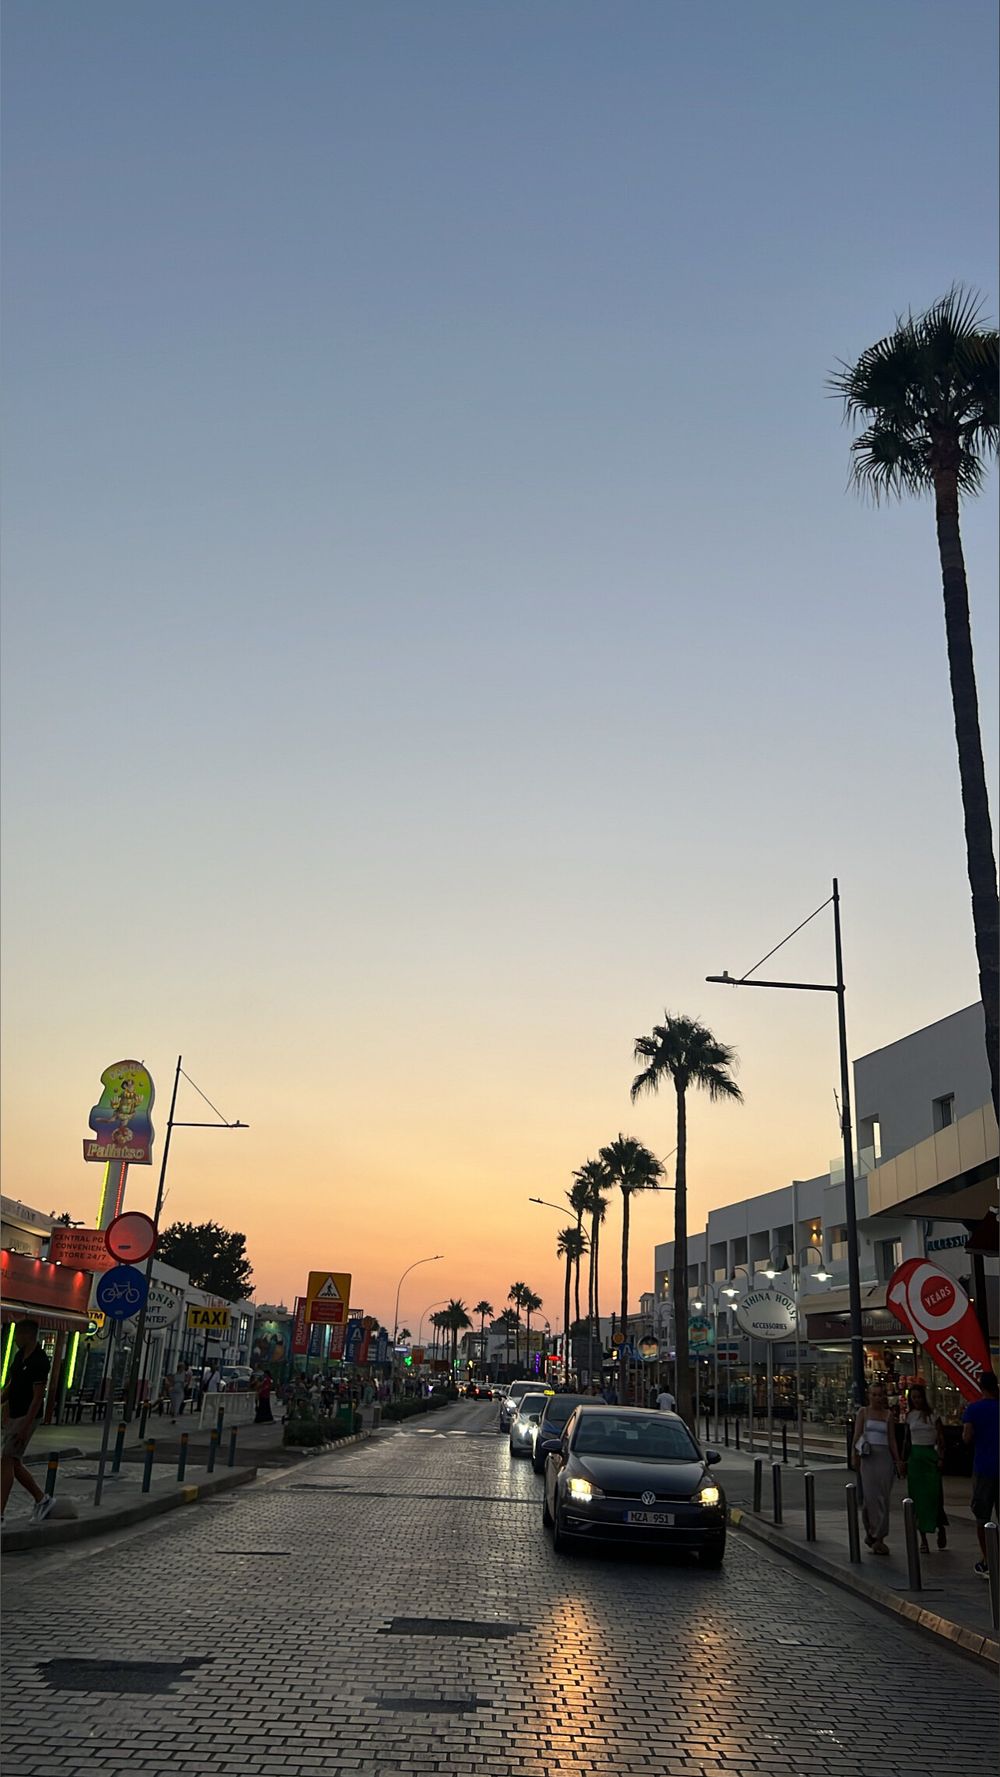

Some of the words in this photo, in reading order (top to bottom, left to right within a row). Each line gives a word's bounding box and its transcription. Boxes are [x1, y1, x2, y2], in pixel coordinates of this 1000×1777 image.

[55, 1234, 89, 1242] CENTRAL
[56, 1243, 107, 1252] CONVENIENC
[149, 1292, 175, 1308] ONIS
[925, 1286, 951, 1307] YEARS
[741, 1293, 771, 1313] ATHINA
[775, 1294, 798, 1320] HOUSE
[136, 1315, 167, 1323] CNTER
[191, 1311, 227, 1325] TAXI
[752, 1322, 787, 1330] ACCESSORIES
[942, 1335, 984, 1383] Frank
[654, 1514, 669, 1523] 951
